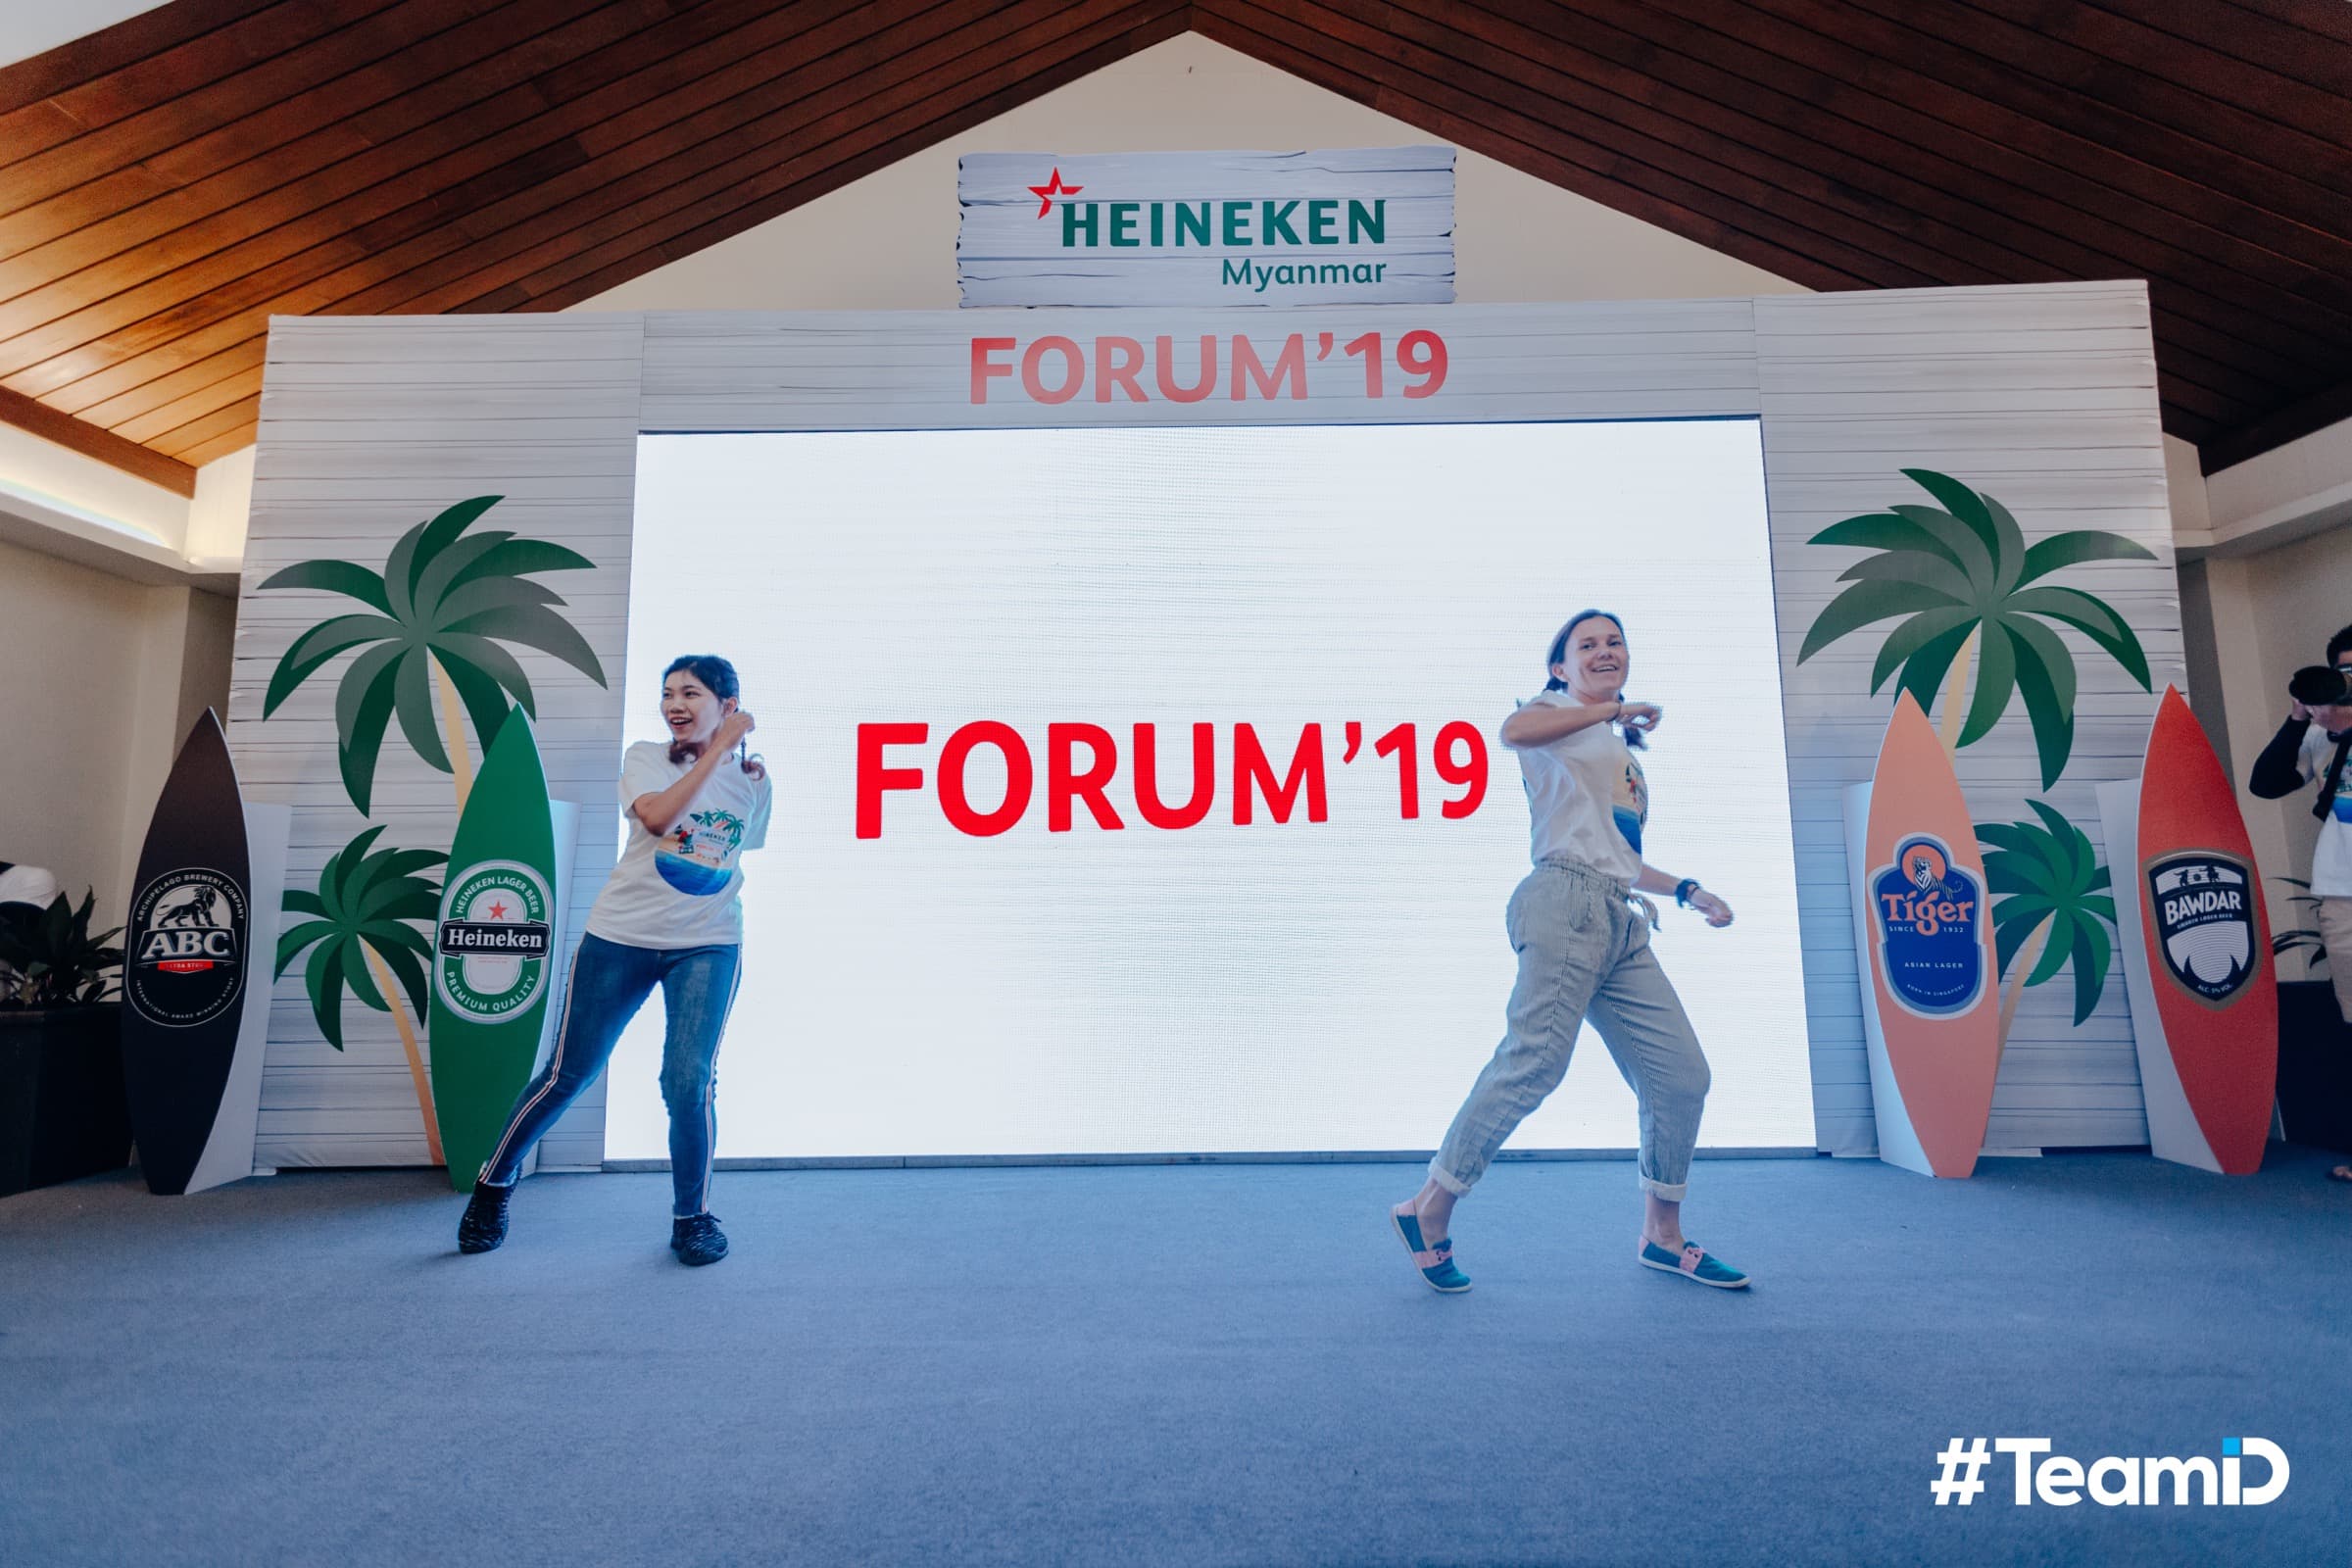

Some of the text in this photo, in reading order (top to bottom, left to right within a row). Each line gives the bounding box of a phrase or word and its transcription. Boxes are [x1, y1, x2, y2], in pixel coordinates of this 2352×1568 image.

[1061, 200, 1387, 248] HEINEKEN
[1222, 259, 1388, 293] Myanmar
[970, 329, 1448, 405] FORUM'19
[856, 720, 1489, 840] FORUM'19
[136, 873, 244, 921] ARCHIPELAGO BREWERY COMPANY
[456, 875, 539, 914] HEINEKEN LAGER BEER
[1881, 890, 1974, 937] Tiger
[2164, 890, 2242, 926] BAWDAR
[141, 931, 231, 959] ABC
[447, 928, 543, 949] Heineken
[447, 971, 535, 1012] PREMIUM QUALITY
